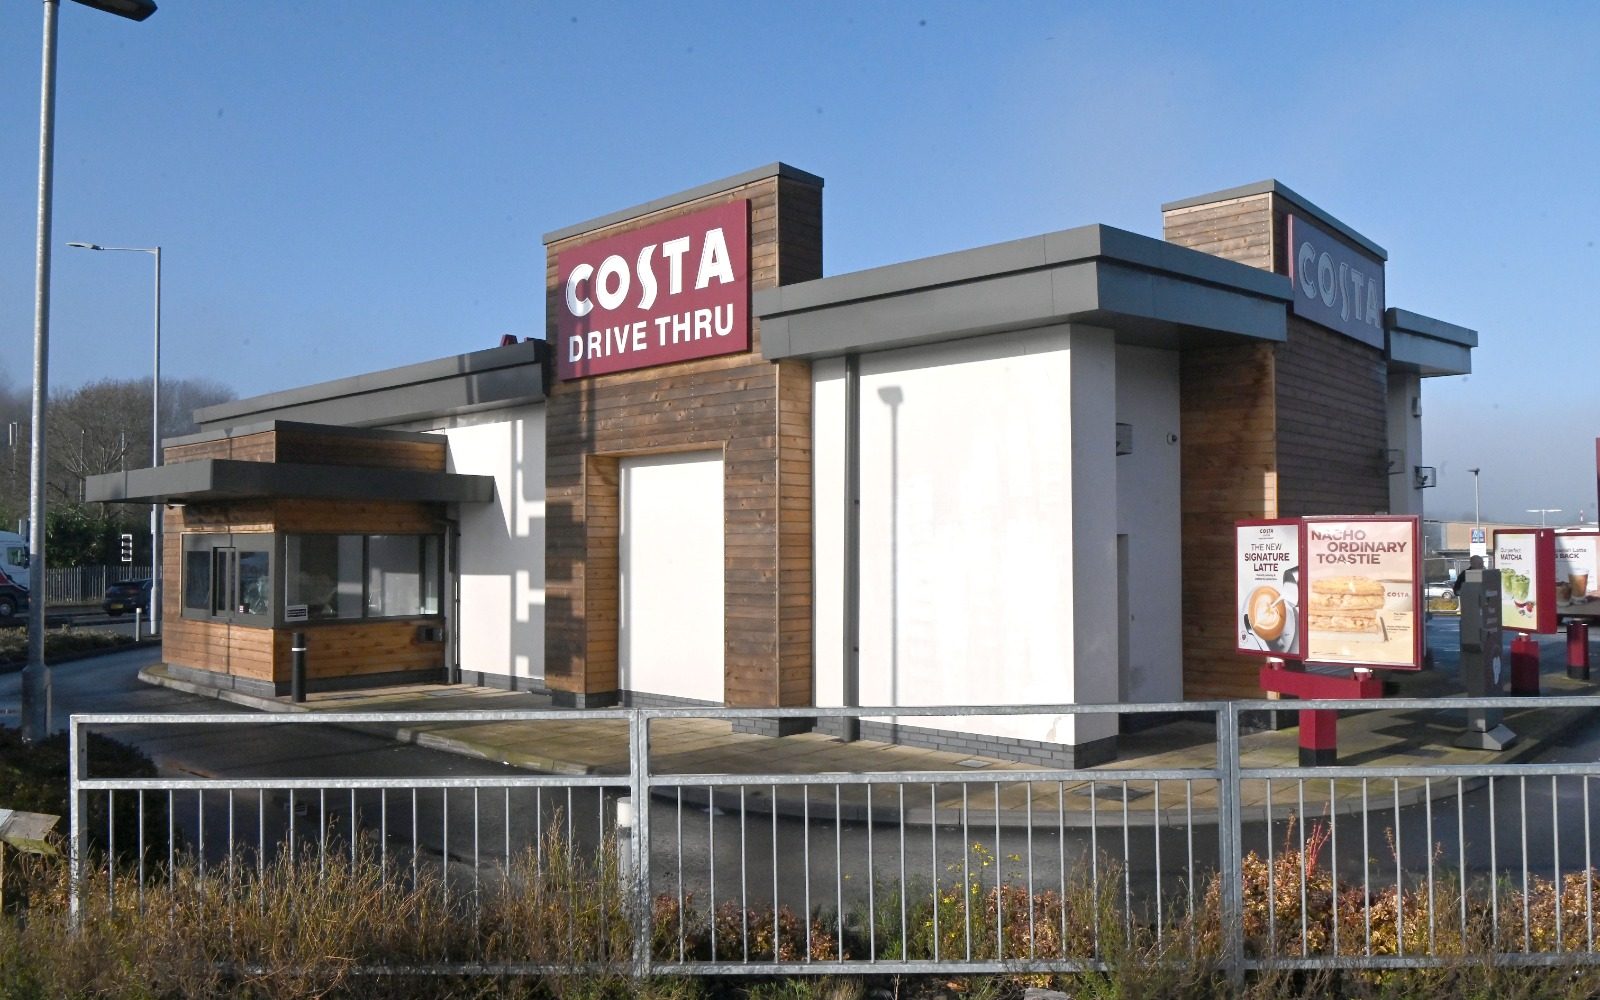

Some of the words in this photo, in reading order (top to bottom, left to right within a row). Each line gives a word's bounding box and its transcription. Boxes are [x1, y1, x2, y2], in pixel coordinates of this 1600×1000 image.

[565, 227, 735, 317] COSTA
[1298, 241, 1381, 329] COSTA
[568, 321, 647, 363] DRIVE
[654, 303, 734, 347] THRU
[1250, 543, 1265, 551] THE
[1265, 543, 1282, 551] NEW
[1327, 541, 1407, 553] ORDINARY
[1244, 552, 1290, 562] SIGNATURE
[1316, 553, 1381, 565] TOASTIE
[1500, 553, 1522, 561] MATCHA
[1253, 563, 1279, 572] LATTE
